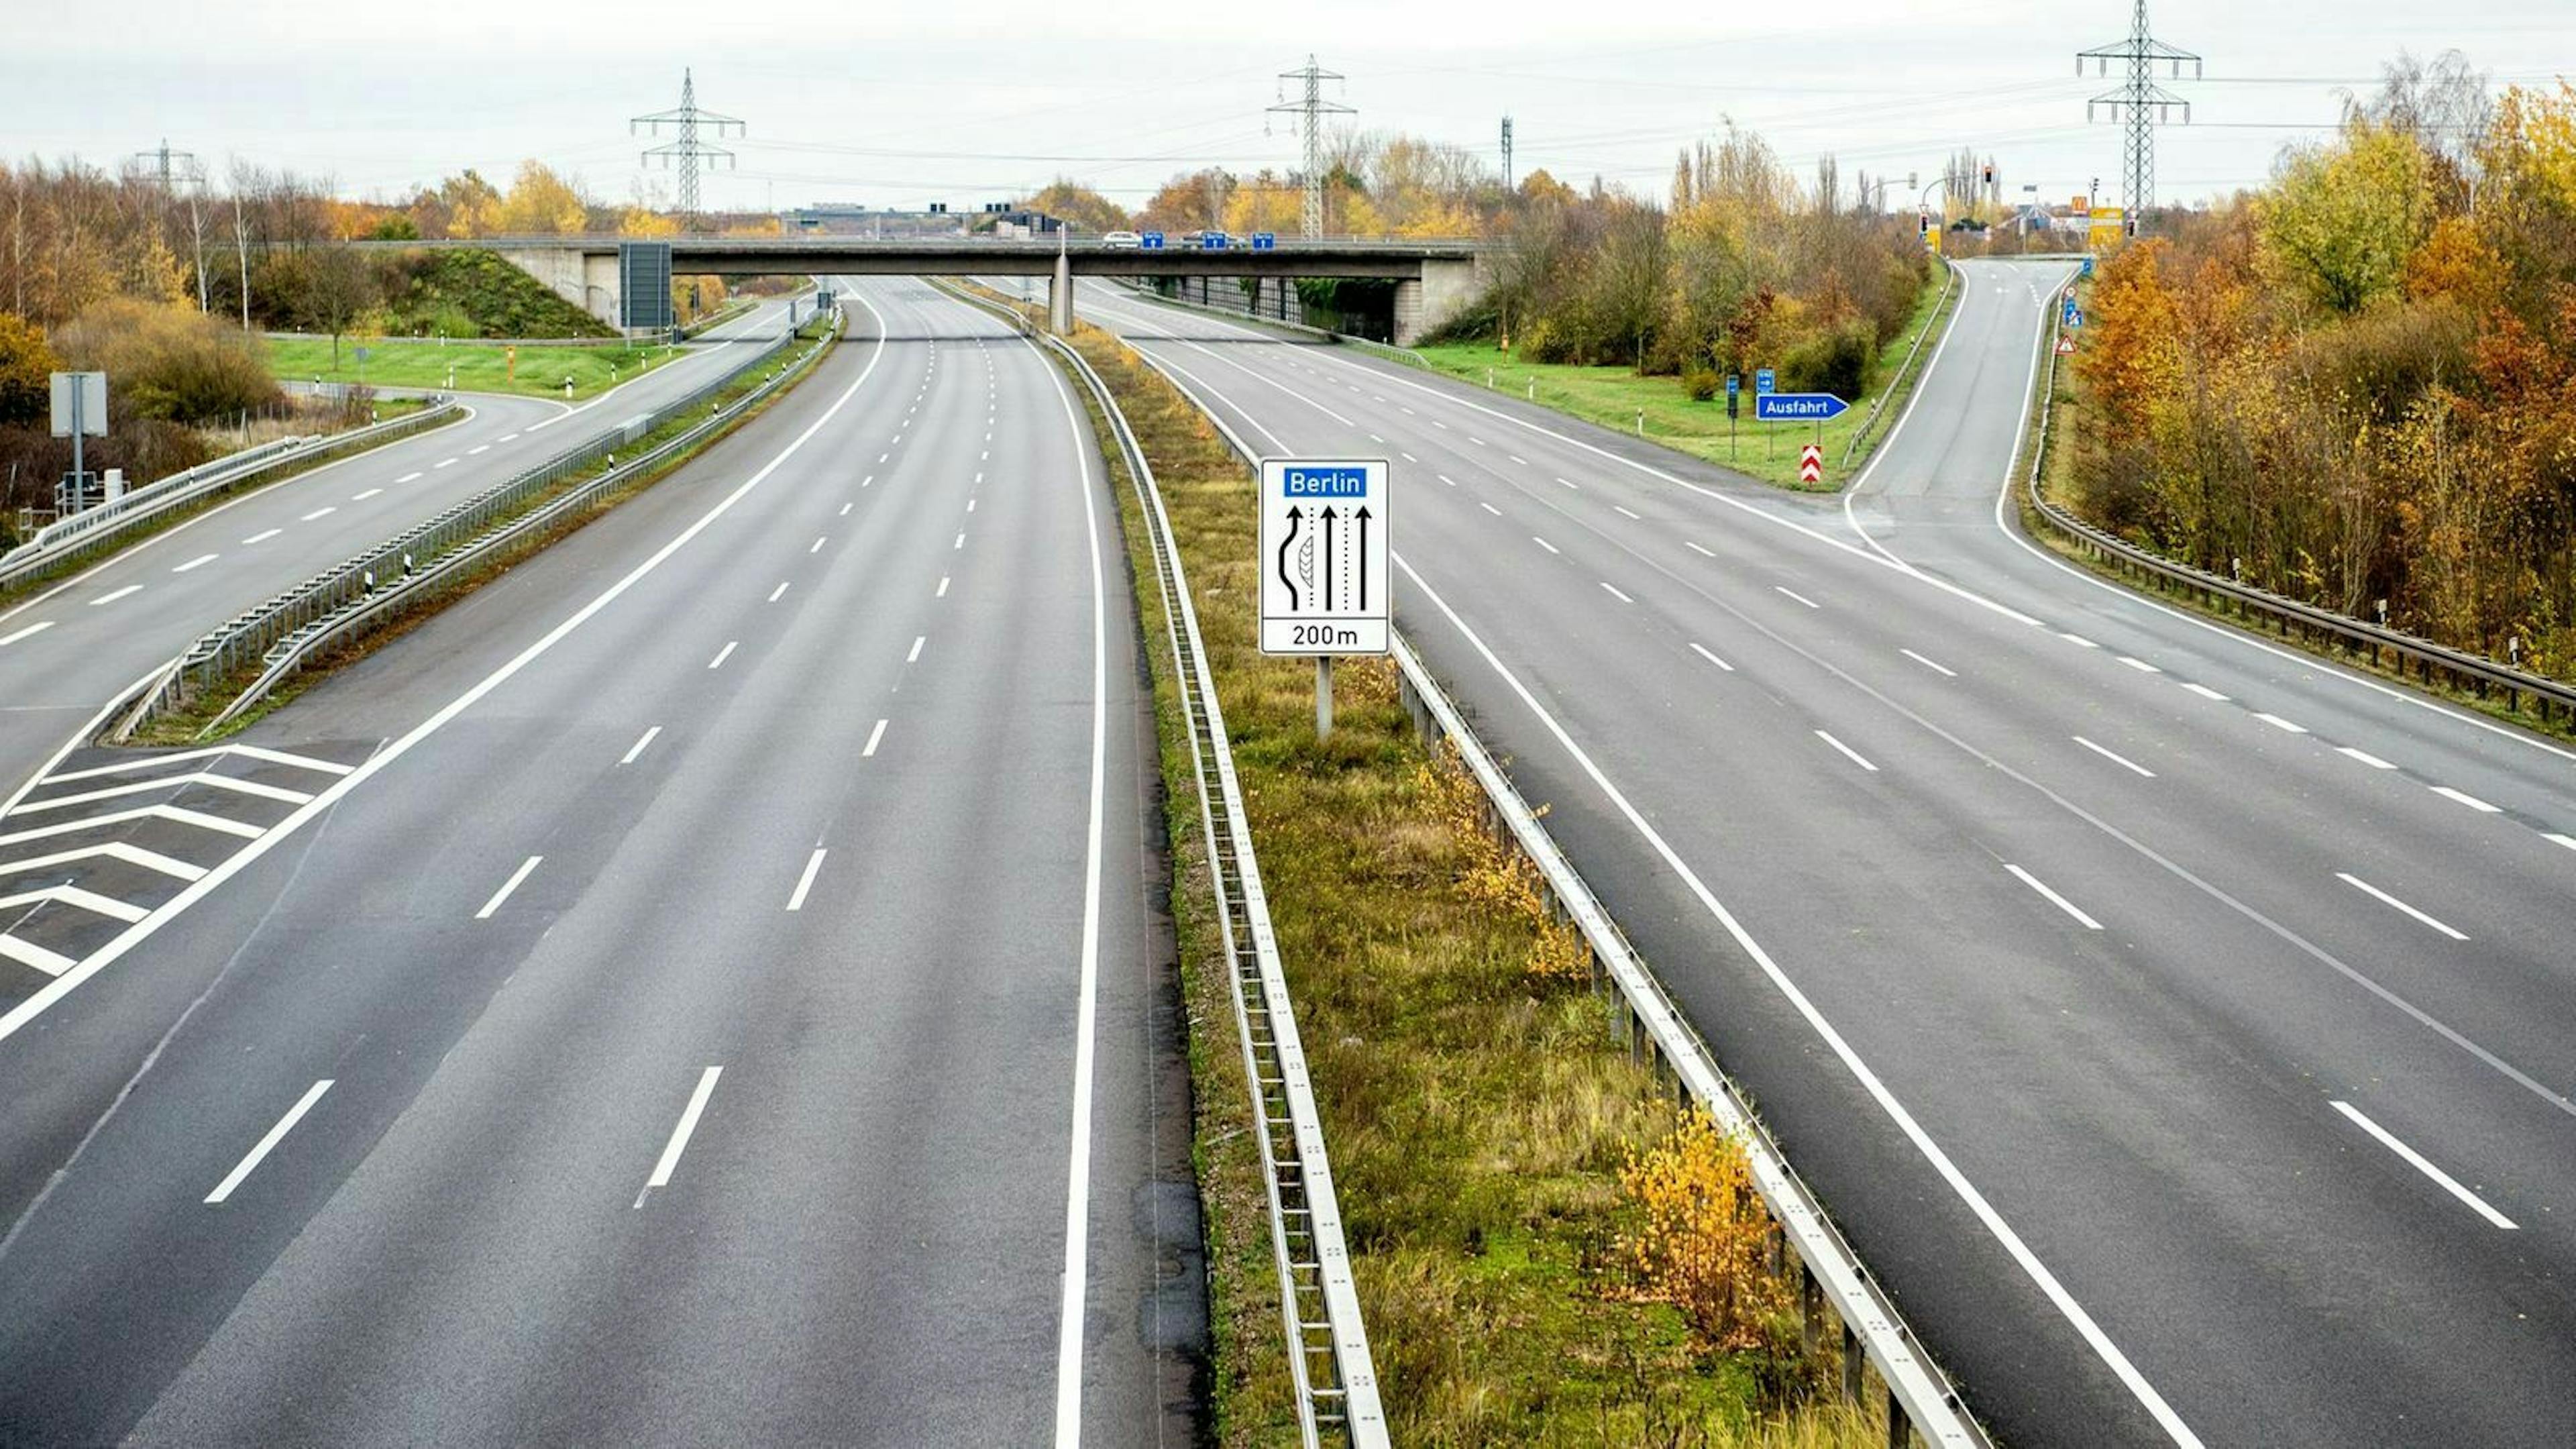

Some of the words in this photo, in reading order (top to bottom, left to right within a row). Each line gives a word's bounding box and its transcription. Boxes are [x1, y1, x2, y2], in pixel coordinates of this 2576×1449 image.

[1766, 400, 1828, 413] Ausfahrt
[1290, 472, 1360, 492] Berlin
[1293, 626, 1333, 645] 200
[1338, 631, 1358, 645] m
